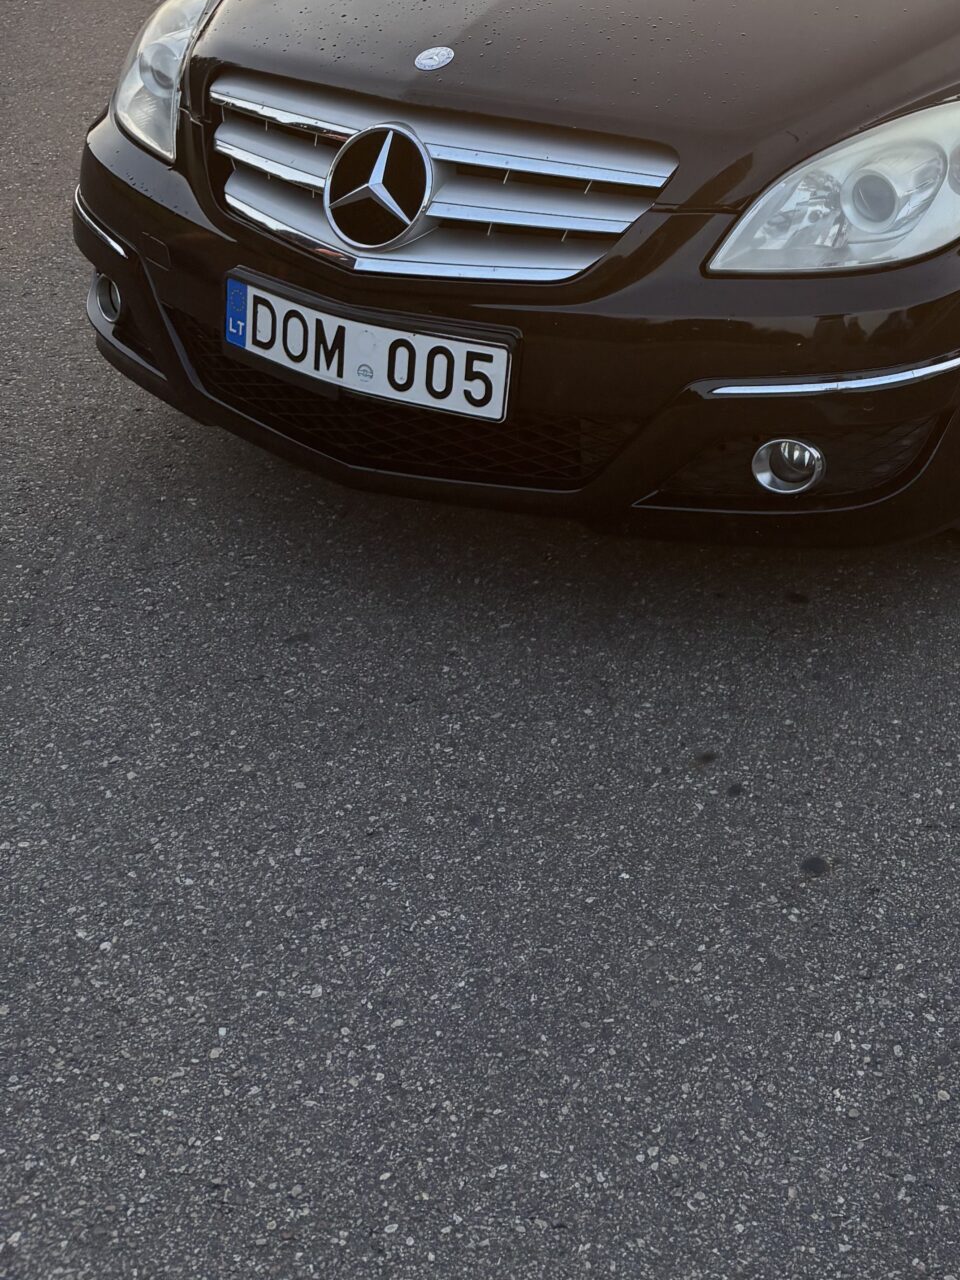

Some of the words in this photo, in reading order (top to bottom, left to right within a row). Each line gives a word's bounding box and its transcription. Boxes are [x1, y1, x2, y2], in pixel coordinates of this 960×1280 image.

[229, 317, 245, 336] LT
[251, 294, 346, 379] DOM
[387, 338, 494, 408] 005
